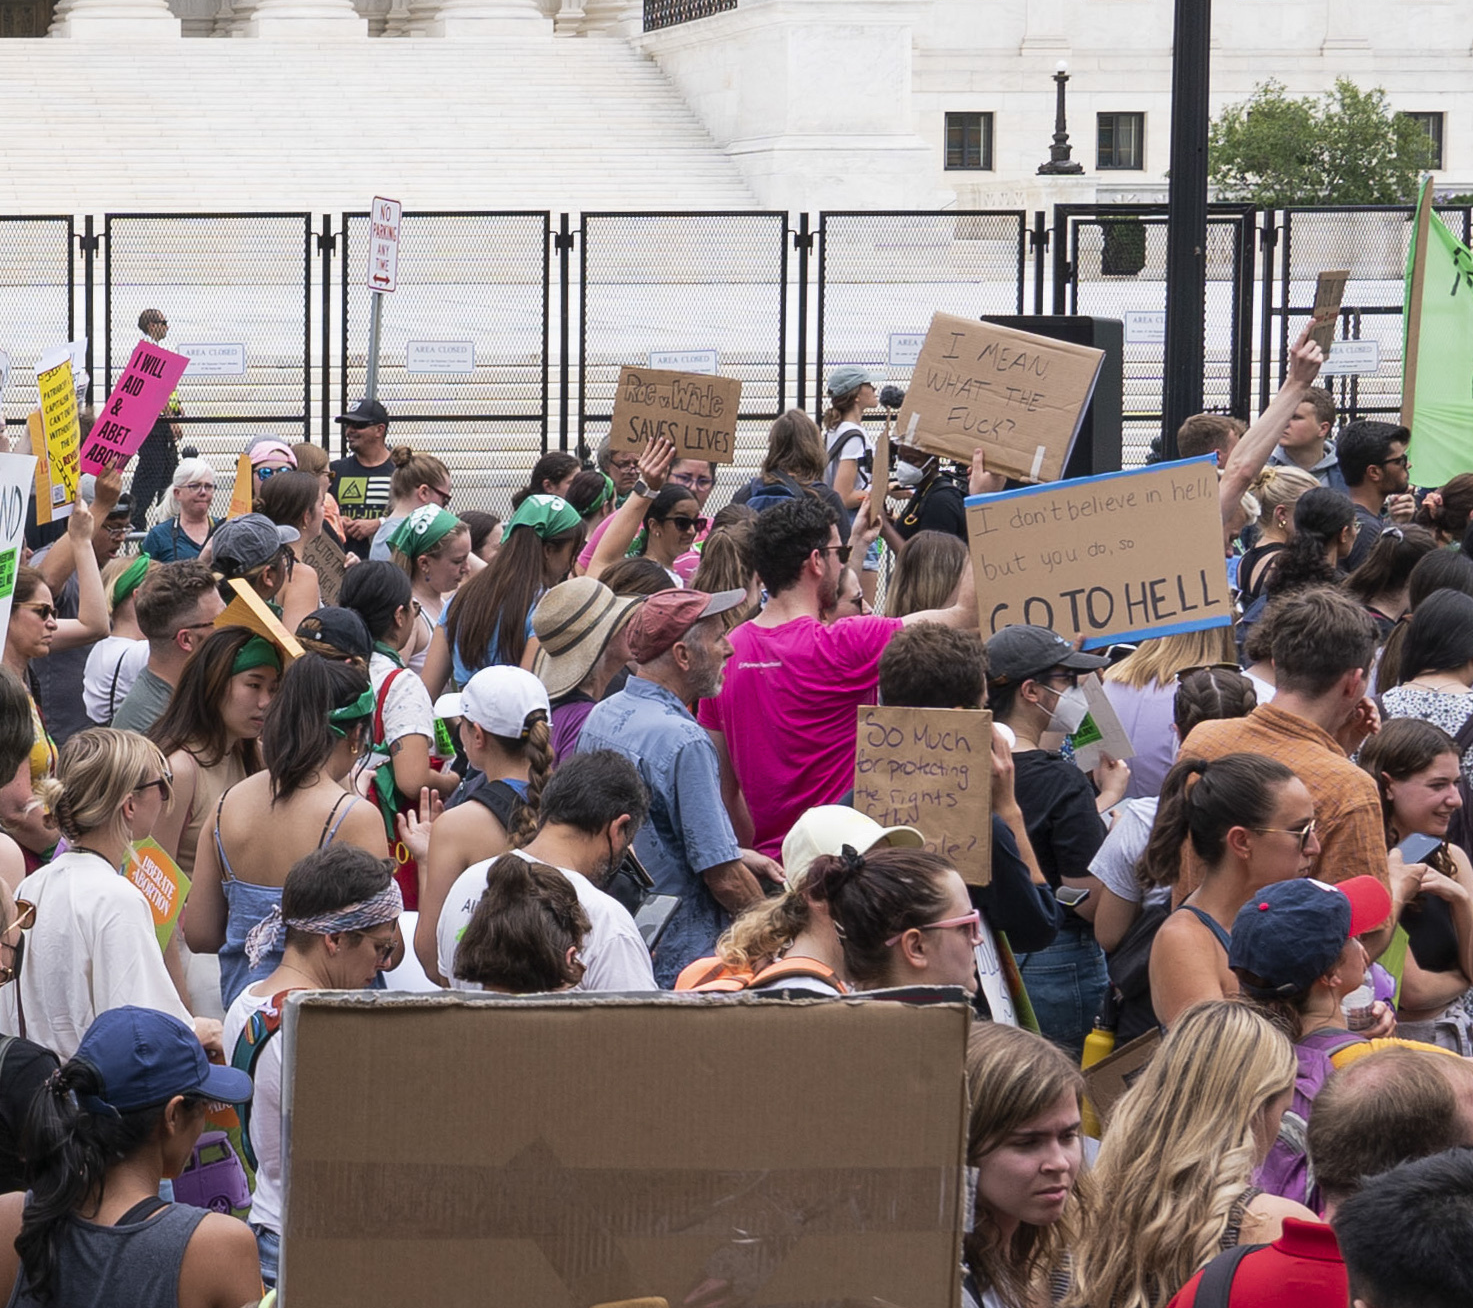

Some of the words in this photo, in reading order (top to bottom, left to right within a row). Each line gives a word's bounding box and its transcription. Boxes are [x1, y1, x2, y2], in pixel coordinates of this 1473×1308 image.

[380, 204, 391, 222] NO
[372, 222, 396, 243] PARKING
[377, 244, 390, 257] ANY
[375, 257, 390, 272] TIME
[134, 351, 144, 369] I
[140, 354, 167, 379] WILL
[208, 348, 237, 356] CLOSED
[438, 346, 468, 354] CLOSED
[657, 357, 678, 365] AREA
[681, 355, 710, 364] CLOSED
[942, 332, 966, 359] I
[977, 342, 1051, 381] MEAN,
[121, 375, 146, 397] AID
[624, 374, 656, 407] Roe
[670, 380, 724, 419] Wade
[926, 368, 992, 402] WHAT
[1006, 386, 1046, 413] THE
[109, 398, 123, 417] &
[946, 406, 1017, 441] FUCK?
[97, 420, 132, 446] ABET
[627, 416, 679, 450] SAVES
[684, 425, 731, 454] LIVES
[971, 507, 1000, 537] I
[1009, 503, 1063, 530] don't
[1066, 488, 1140, 522] believe
[1146, 487, 1164, 504] in
[1171, 477, 1213, 501] hell,
[980, 554, 1027, 582] but
[1040, 547, 1080, 574] you
[1087, 540, 1115, 559] do,
[1119, 538, 1136, 553] so
[1060, 586, 1116, 634] TO
[1124, 569, 1222, 626] HELL
[866, 712, 905, 748] So
[913, 724, 972, 754] Much
[857, 748, 884, 774] for
[887, 757, 970, 791] protecting
[856, 785, 884, 802] the
[890, 789, 958, 823] rights
[131, 868, 172, 917] ABORTION
[141, 855, 178, 901] LIBERATE
